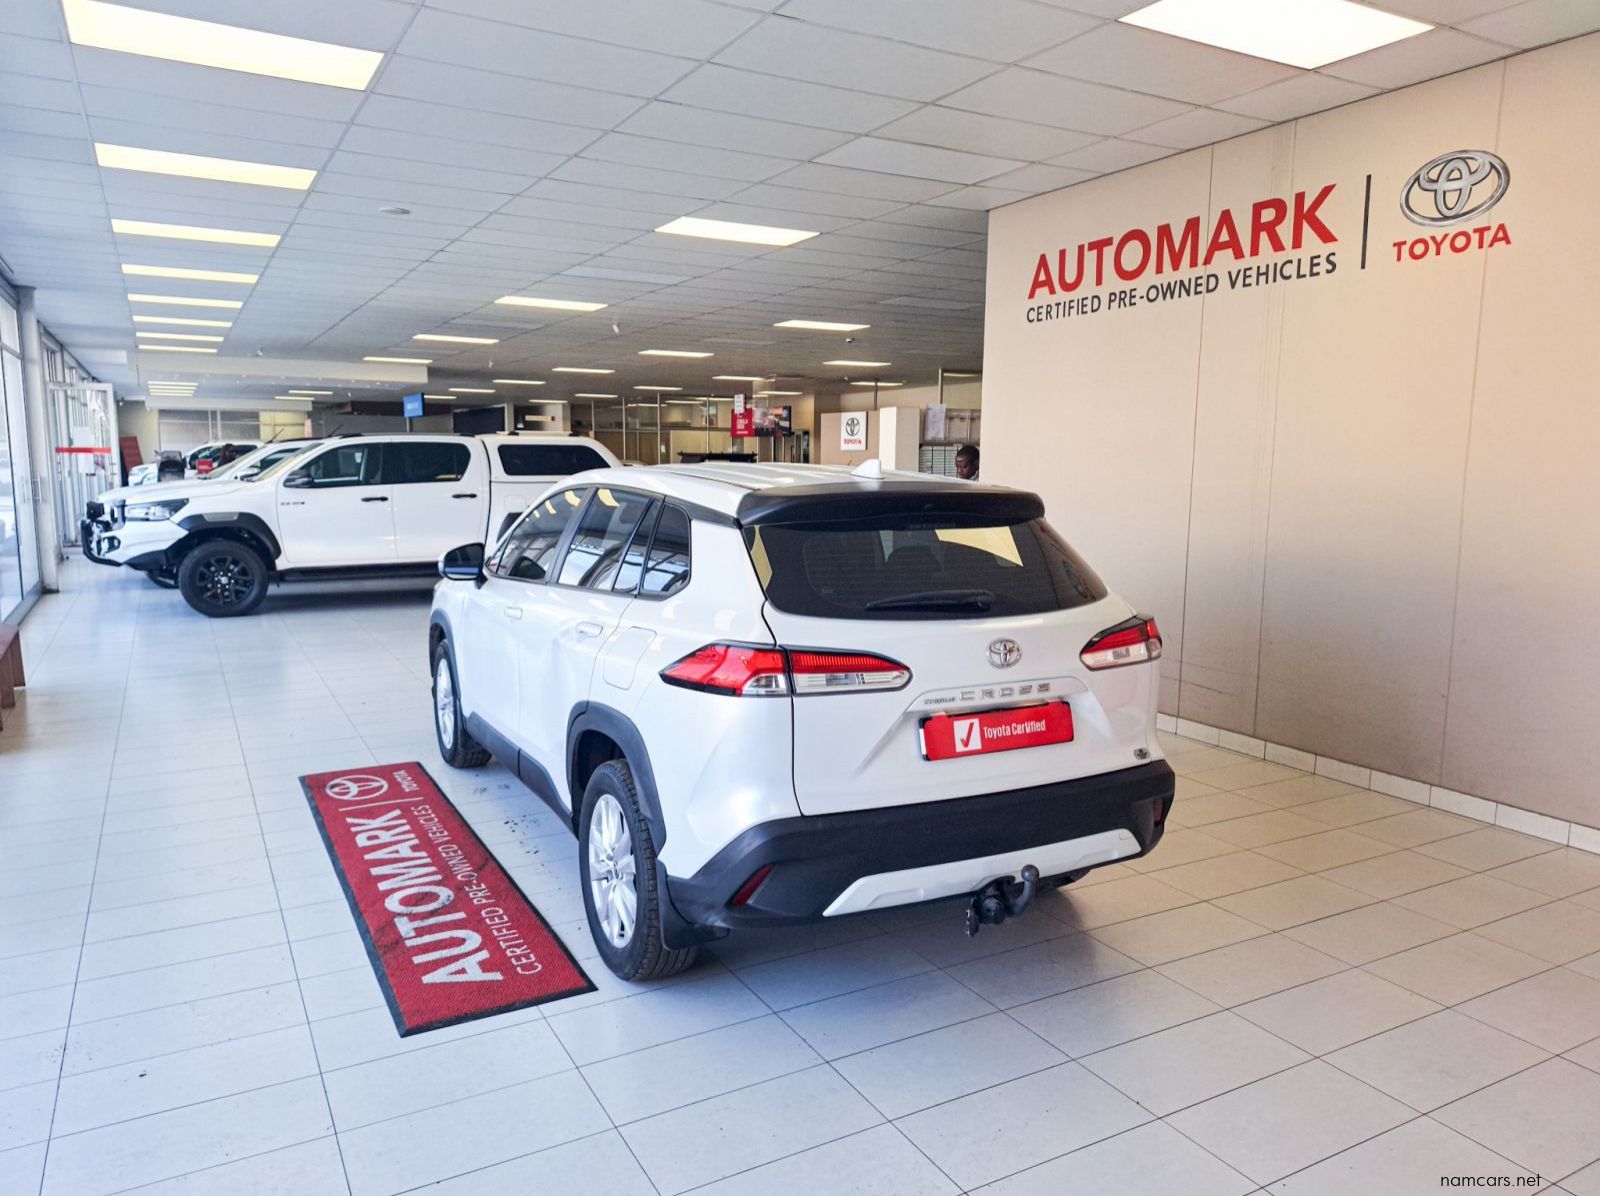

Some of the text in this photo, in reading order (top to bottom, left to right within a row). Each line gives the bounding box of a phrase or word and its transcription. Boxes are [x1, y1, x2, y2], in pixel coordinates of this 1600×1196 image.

[1027, 183, 1338, 299] AUTOMARK
[1393, 223, 1511, 262] TOYOTA
[1026, 252, 1337, 323] CERTIFIED PRE-OWNED VEHICLES
[959, 683, 1050, 701] CROSS
[983, 719, 1046, 739] Toyota Certified
[346, 809, 504, 984] AUTOMARK
[411, 804, 543, 975] CERTIFIED PRE-OWNED VEHICLES
